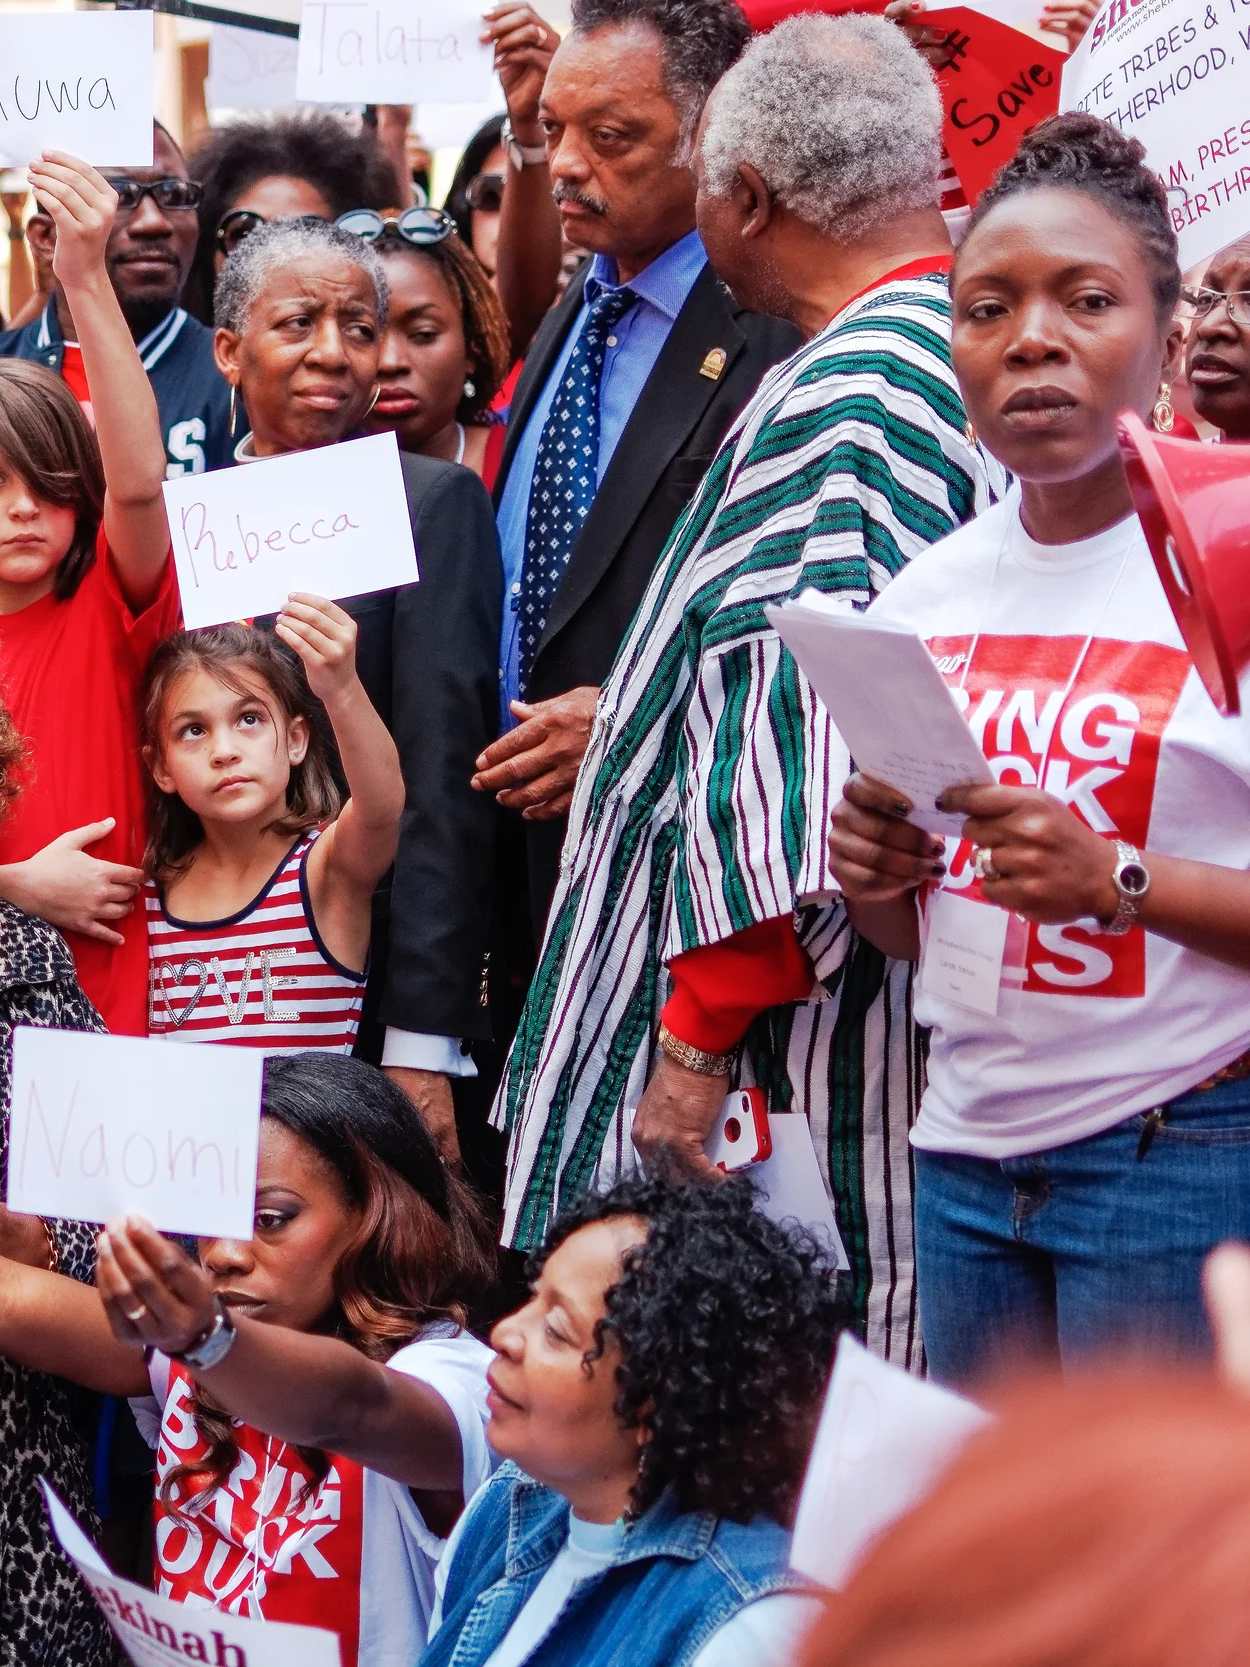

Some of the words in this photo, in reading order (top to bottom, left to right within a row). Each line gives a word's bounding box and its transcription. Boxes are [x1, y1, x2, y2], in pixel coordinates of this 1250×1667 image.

[304, 2, 464, 75] Talata
[1119, 18, 1196, 84] TRIBES
[1204, 5, 1219, 30] &
[950, 64, 1054, 147] Save
[180, 502, 360, 588] Rebecca
[18, 1078, 243, 1196] Naomi
